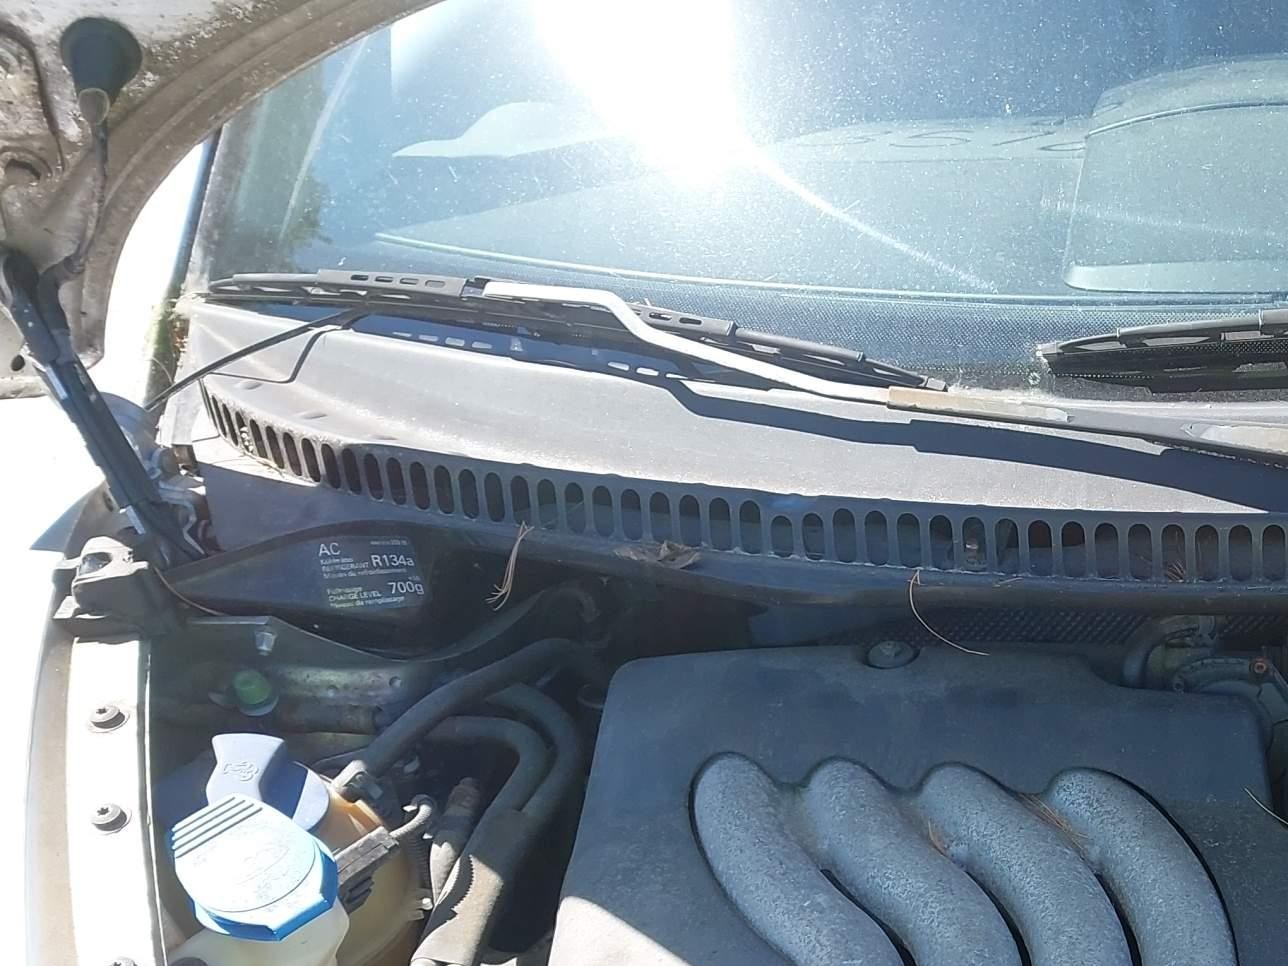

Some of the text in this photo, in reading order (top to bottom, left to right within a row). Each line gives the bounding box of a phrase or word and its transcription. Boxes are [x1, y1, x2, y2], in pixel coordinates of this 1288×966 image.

[318, 542, 341, 556] AC
[370, 554, 414, 568] R134a
[388, 581, 424, 595] 700g
